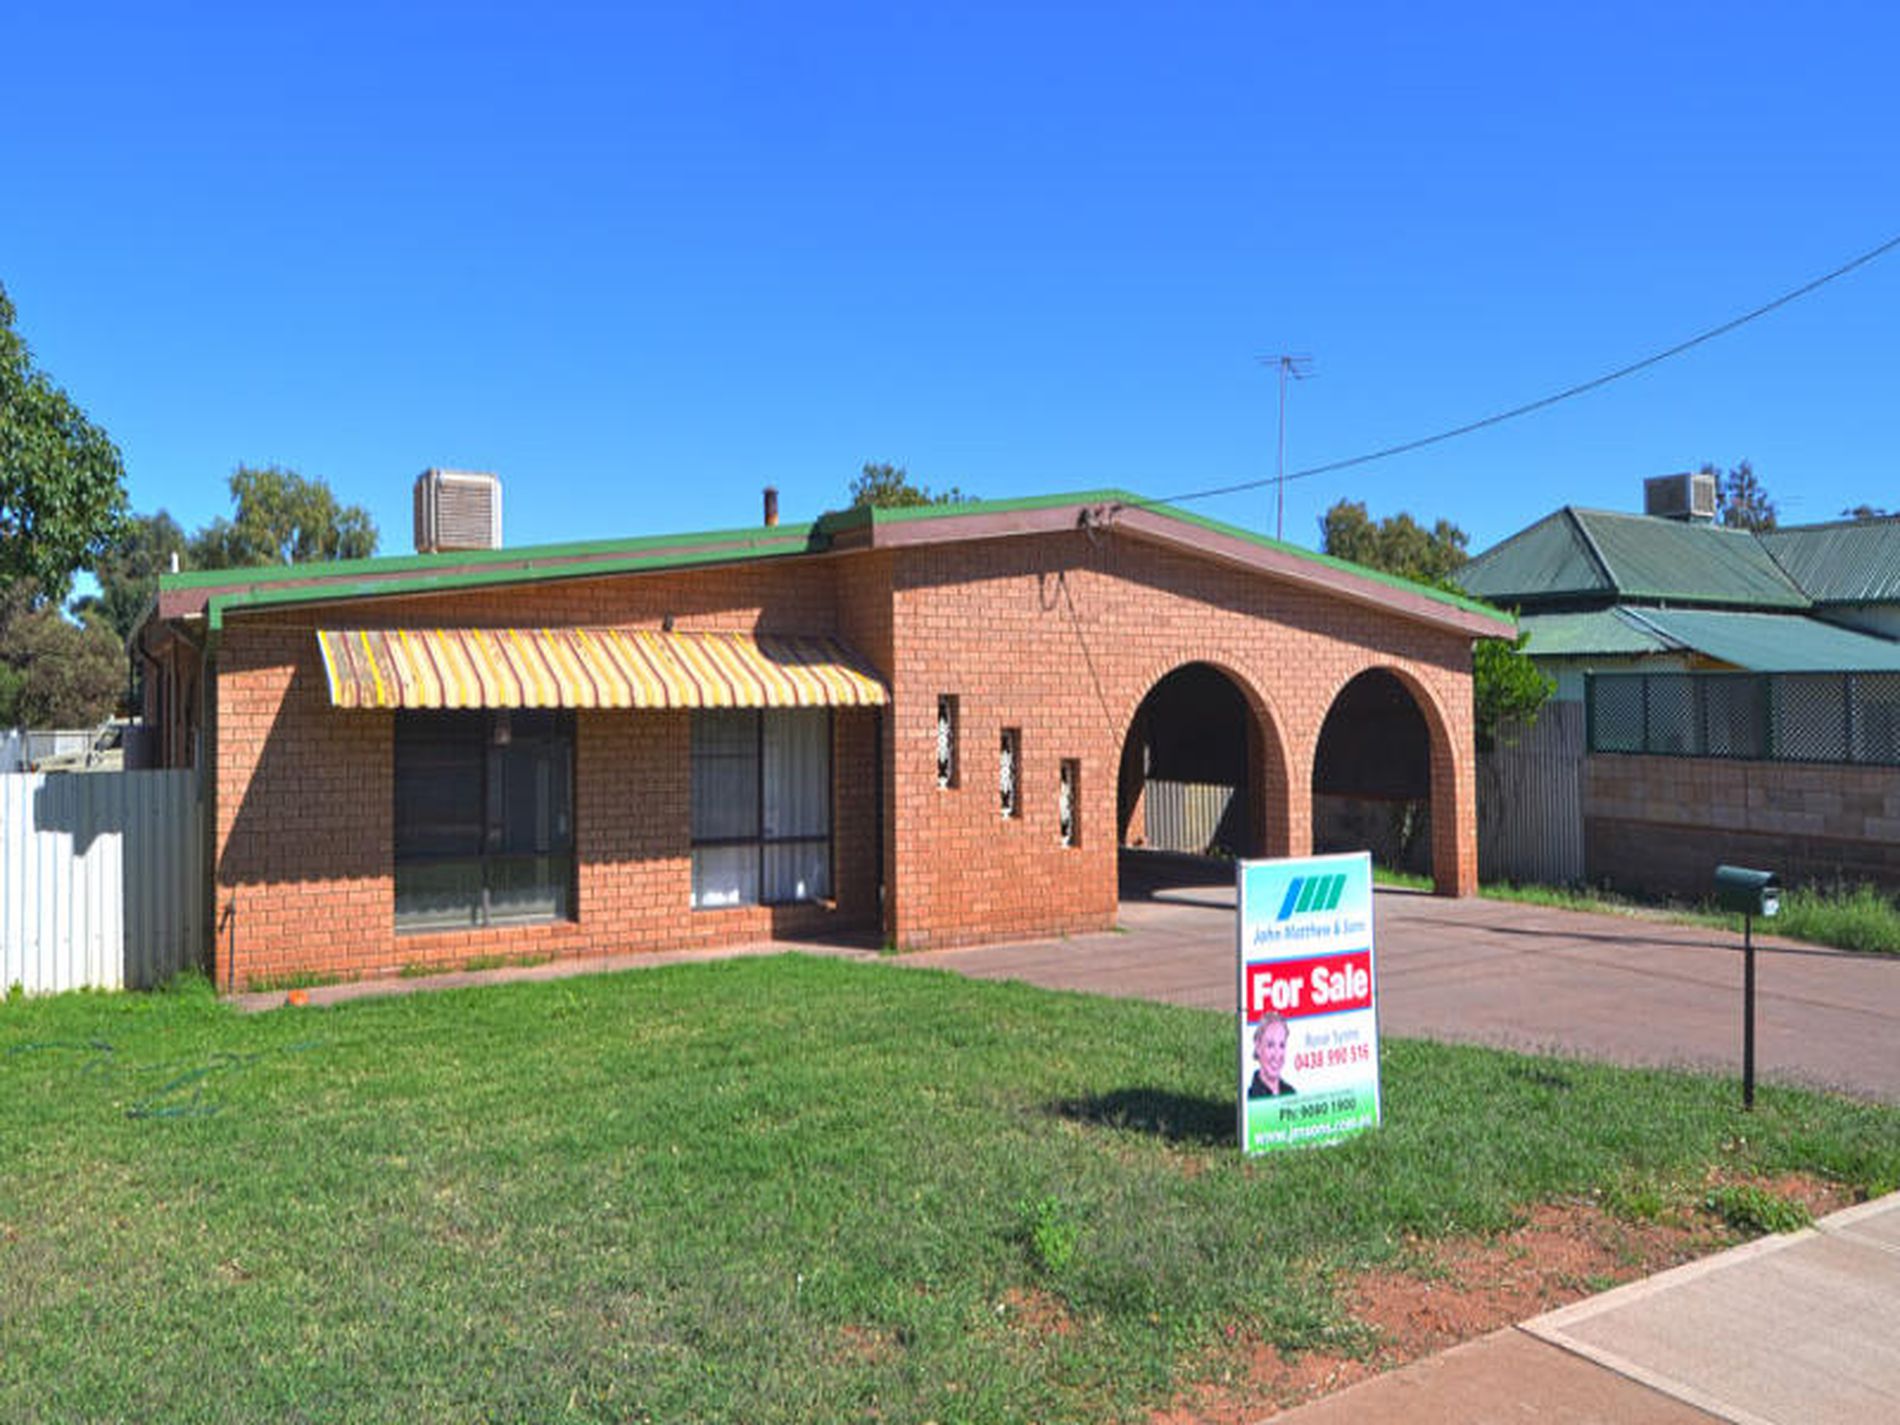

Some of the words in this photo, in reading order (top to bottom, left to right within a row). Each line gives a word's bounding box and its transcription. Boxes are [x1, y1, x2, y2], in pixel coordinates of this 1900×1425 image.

[1253, 923, 1280, 945] John
[1284, 922, 1330, 941] Matthew
[1334, 919, 1340, 935] &
[1252, 972, 1303, 1011] For
[1310, 962, 1369, 1006] Sale
[1294, 1050, 1324, 1071] 0438
